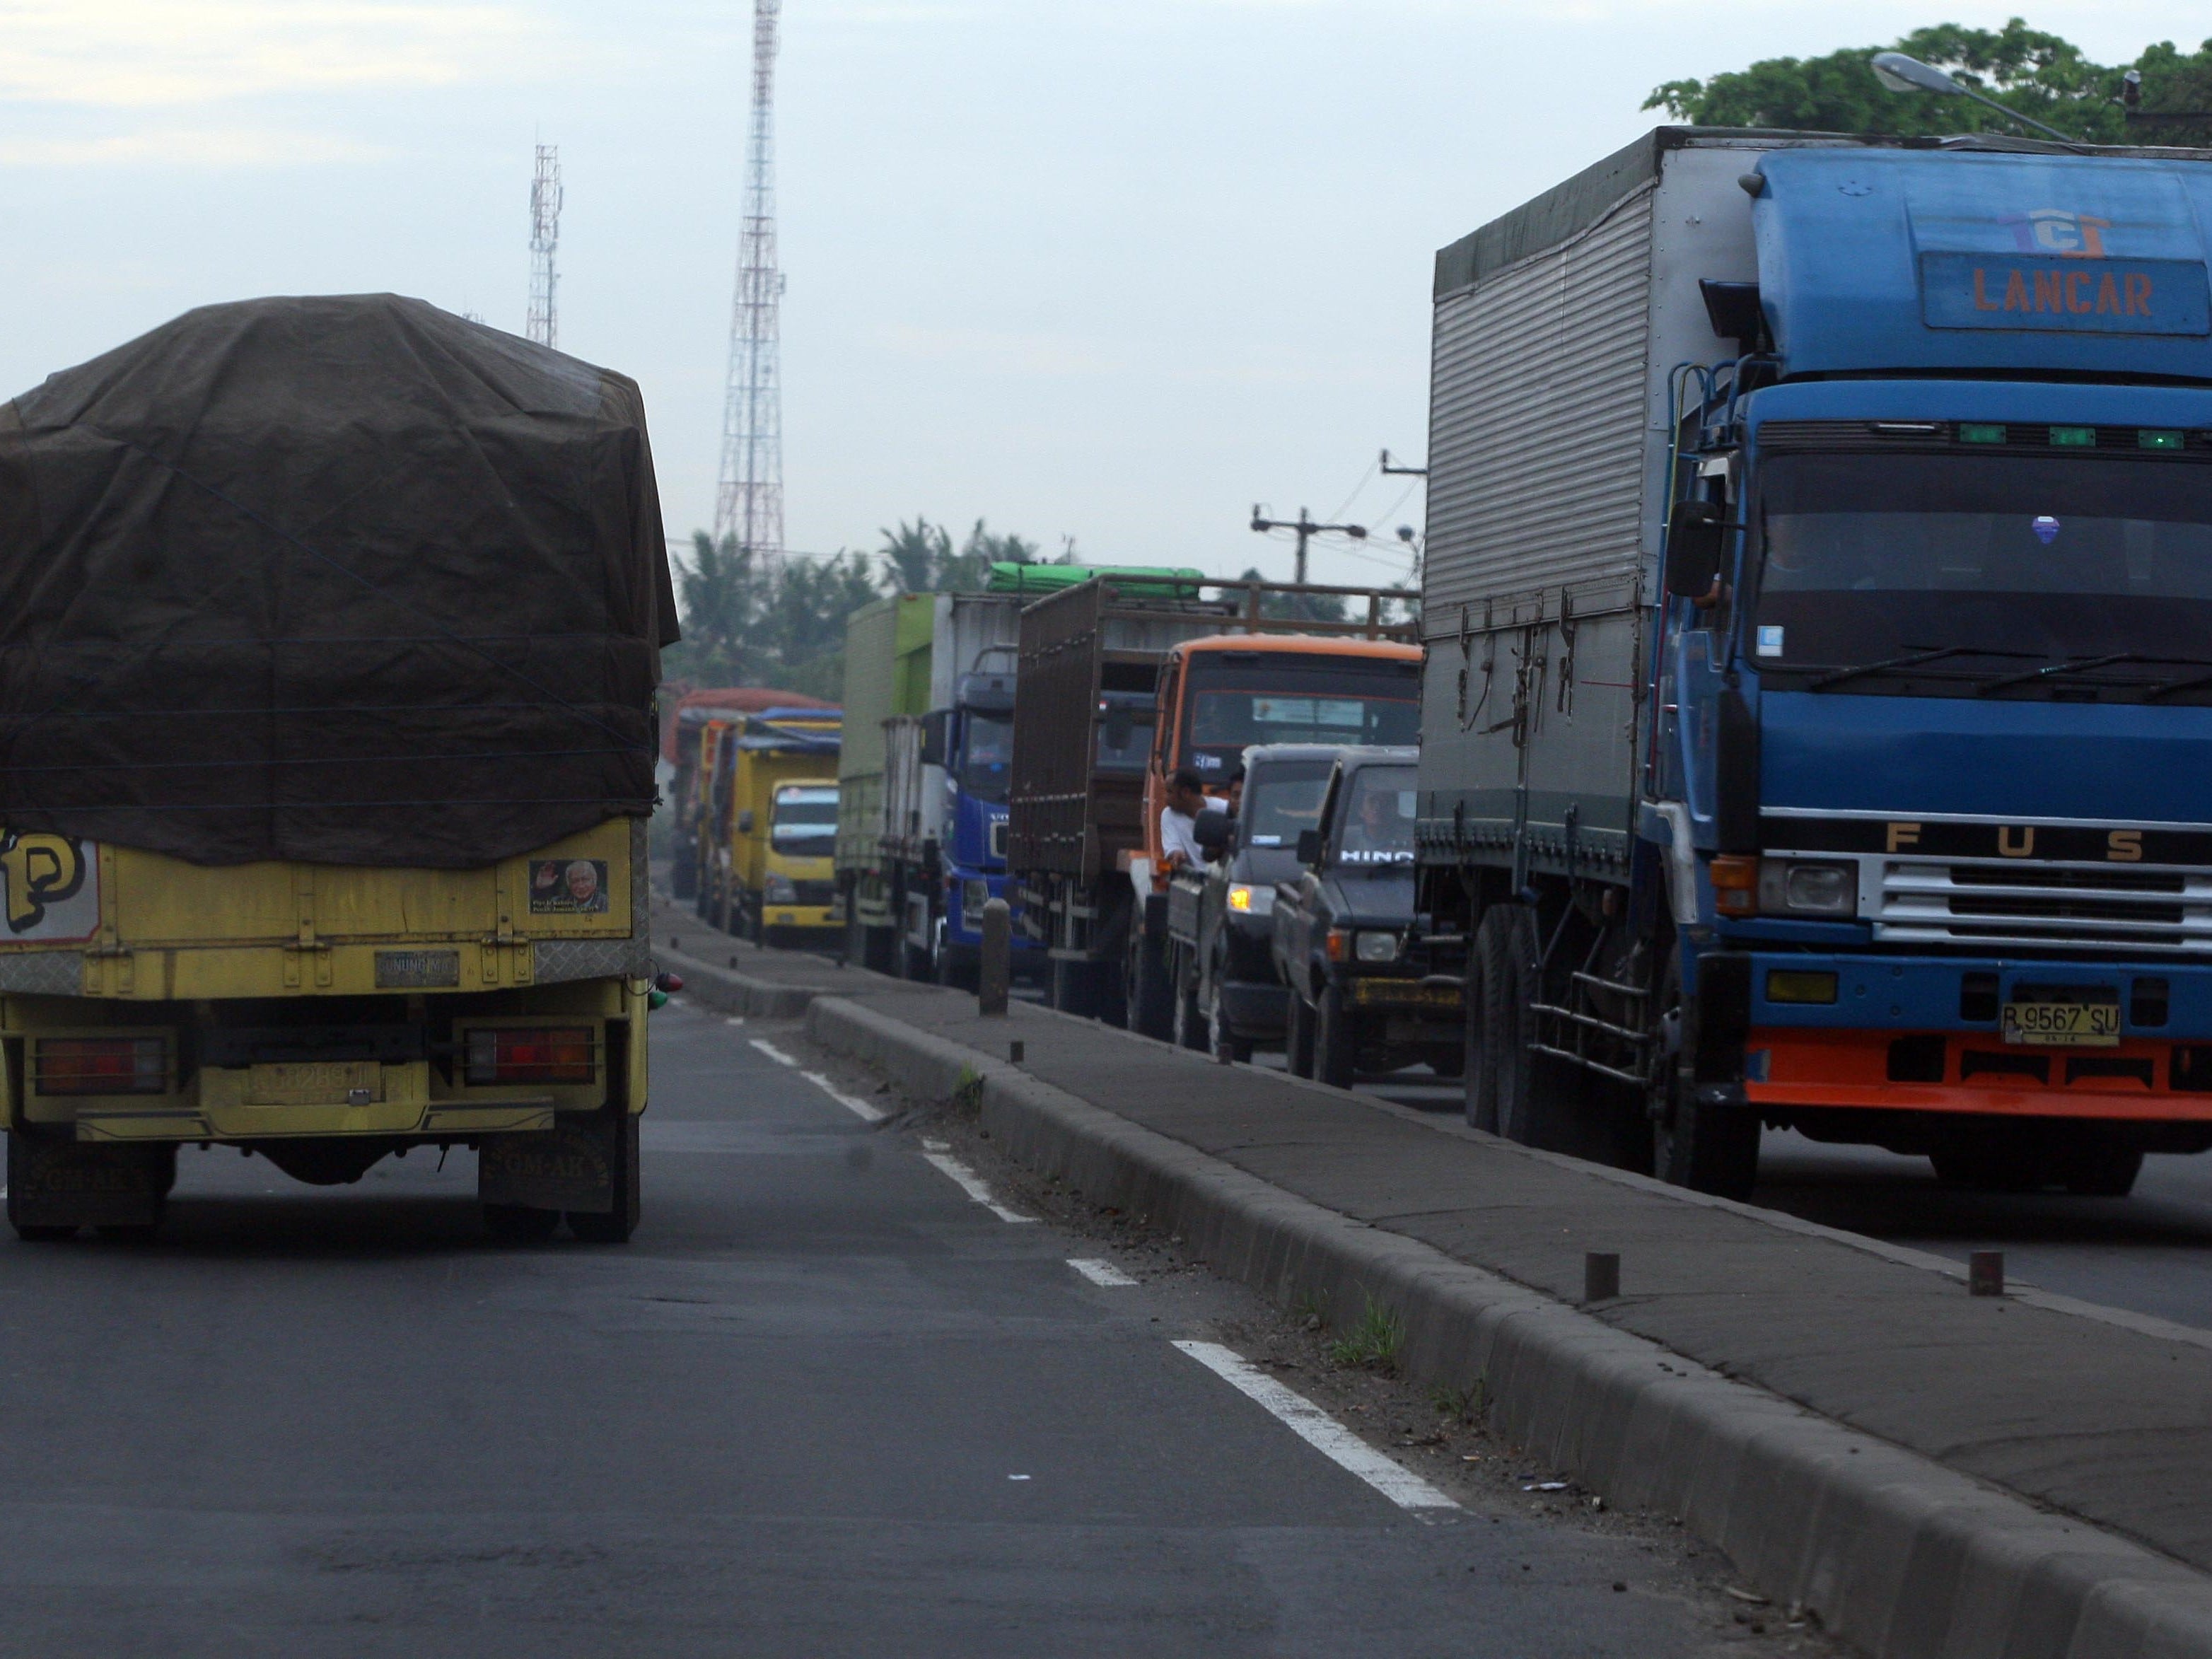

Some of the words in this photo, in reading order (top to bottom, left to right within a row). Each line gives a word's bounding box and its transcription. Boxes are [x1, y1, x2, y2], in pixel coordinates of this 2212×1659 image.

[1973, 267, 2153, 317] LANCAR
[2024, 1006, 2081, 1031] 9567
[2091, 1008, 2119, 1032] SU
